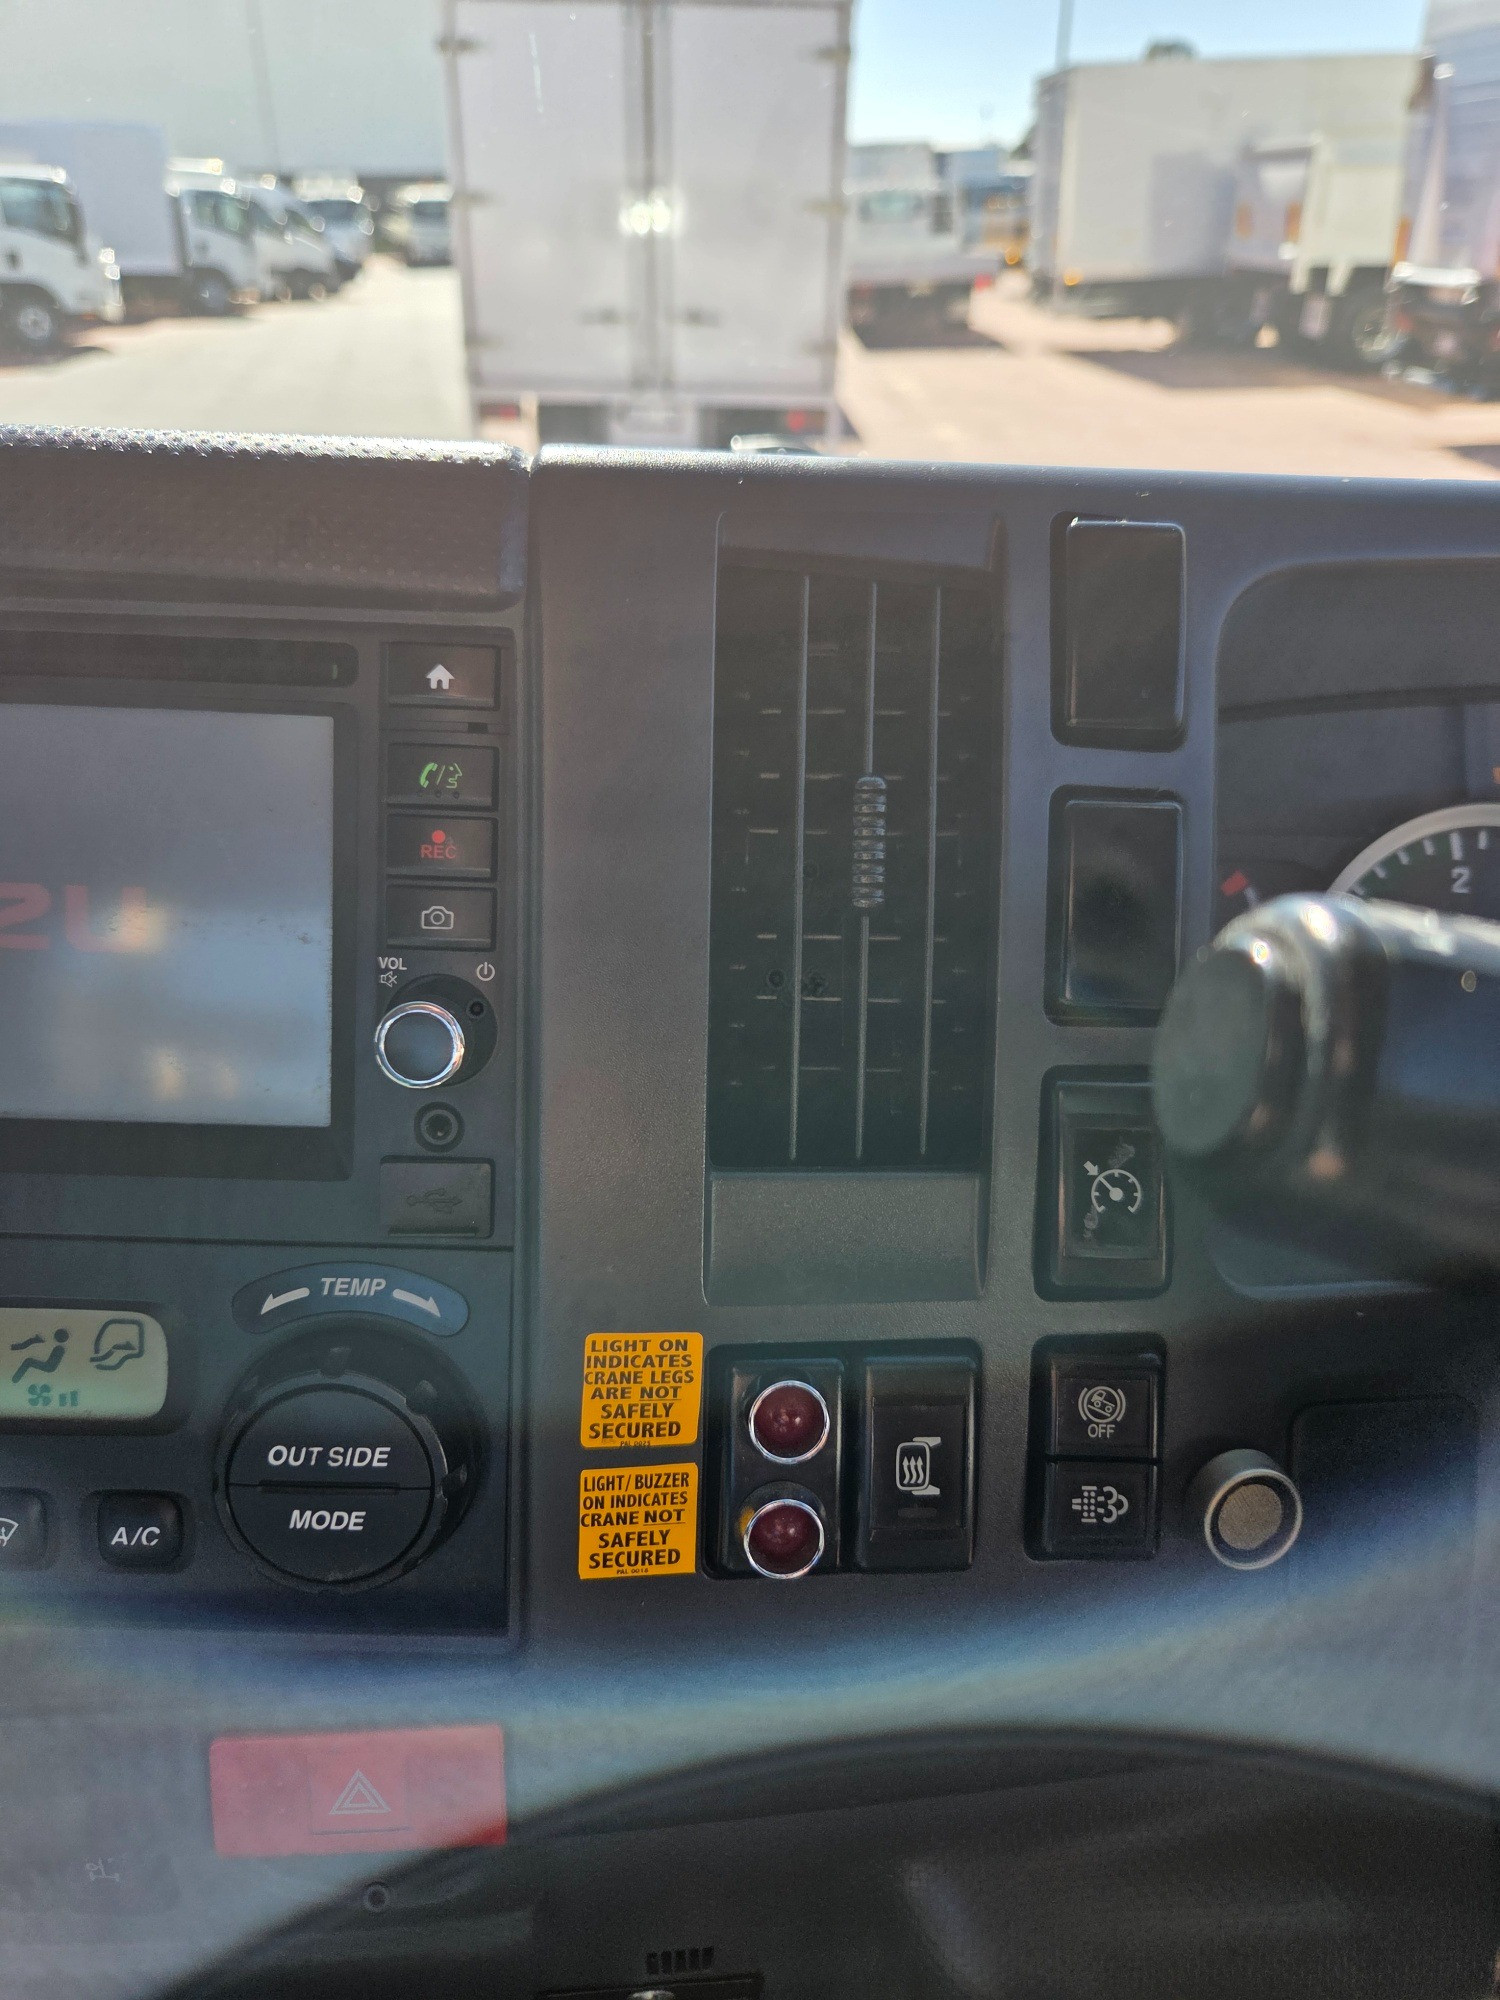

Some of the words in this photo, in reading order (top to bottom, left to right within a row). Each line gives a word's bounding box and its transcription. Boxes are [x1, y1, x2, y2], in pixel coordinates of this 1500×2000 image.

[420, 844, 457, 859] REC
[1451, 866, 1471, 894] 2
[378, 956, 407, 970] VOL
[321, 1277, 387, 1296] TEMP
[591, 1339, 651, 1352] LIGHT
[659, 1338, 688, 1352] ON
[586, 1354, 692, 1369] INDICATES
[584, 1371, 643, 1385] CRANE
[650, 1369, 694, 1384] LEGS
[590, 1386, 632, 1400] ARE
[639, 1385, 682, 1399] NOT
[600, 1402, 674, 1419] SAFELY
[588, 1420, 681, 1439] SECURED
[1087, 1423, 1116, 1439] OFF
[267, 1445, 323, 1467] OUT
[327, 1446, 391, 1468] SIDE
[582, 1495, 605, 1510] ON
[610, 1490, 688, 1509] INDICATES
[289, 1509, 367, 1531] MODE
[580, 1510, 639, 1528] CRANE
[643, 1508, 686, 1524] NOT
[110, 1526, 161, 1546] A/C
[598, 1529, 671, 1549] SAFELY
[588, 1548, 681, 1570] SECURED
